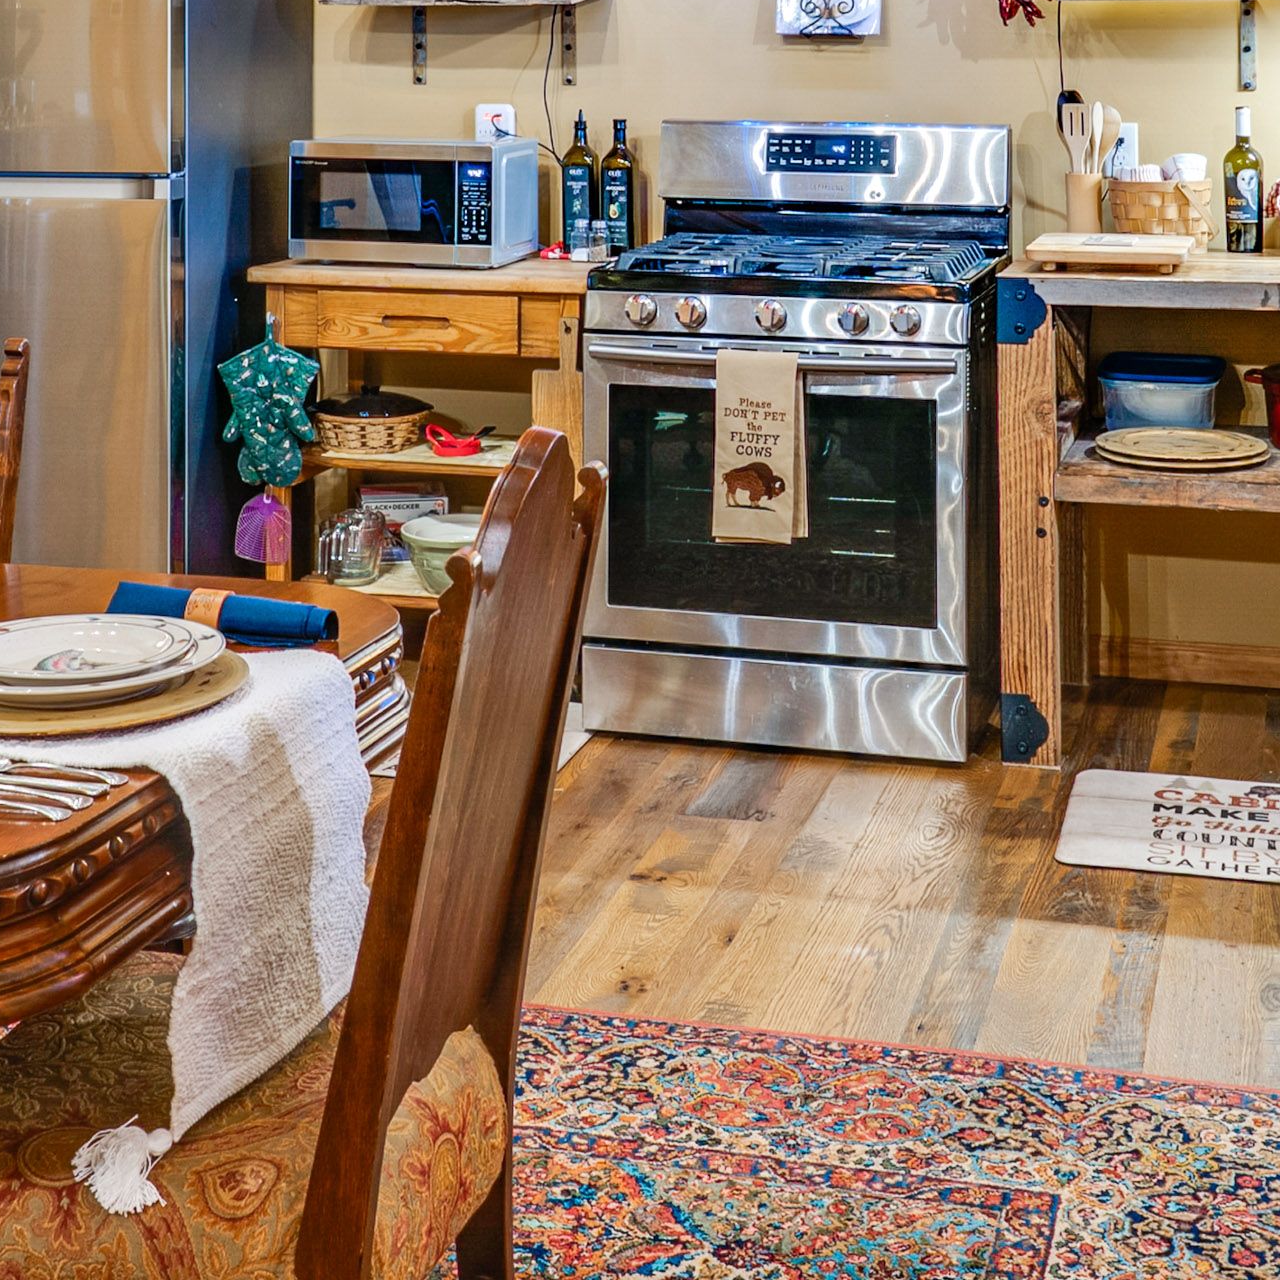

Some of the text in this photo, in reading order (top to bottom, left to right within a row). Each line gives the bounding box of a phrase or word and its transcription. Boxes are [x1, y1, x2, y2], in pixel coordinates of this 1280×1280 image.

[739, 397, 772, 409] Please
[724, 407, 787, 422] DON'T PET
[747, 421, 763, 432] the
[730, 431, 781, 446] FLUFFY
[735, 444, 773, 458] COWS
[1152, 803, 1271, 823] MAKE
[1151, 815, 1193, 828] Go
[1148, 841, 1219, 859] SIT
